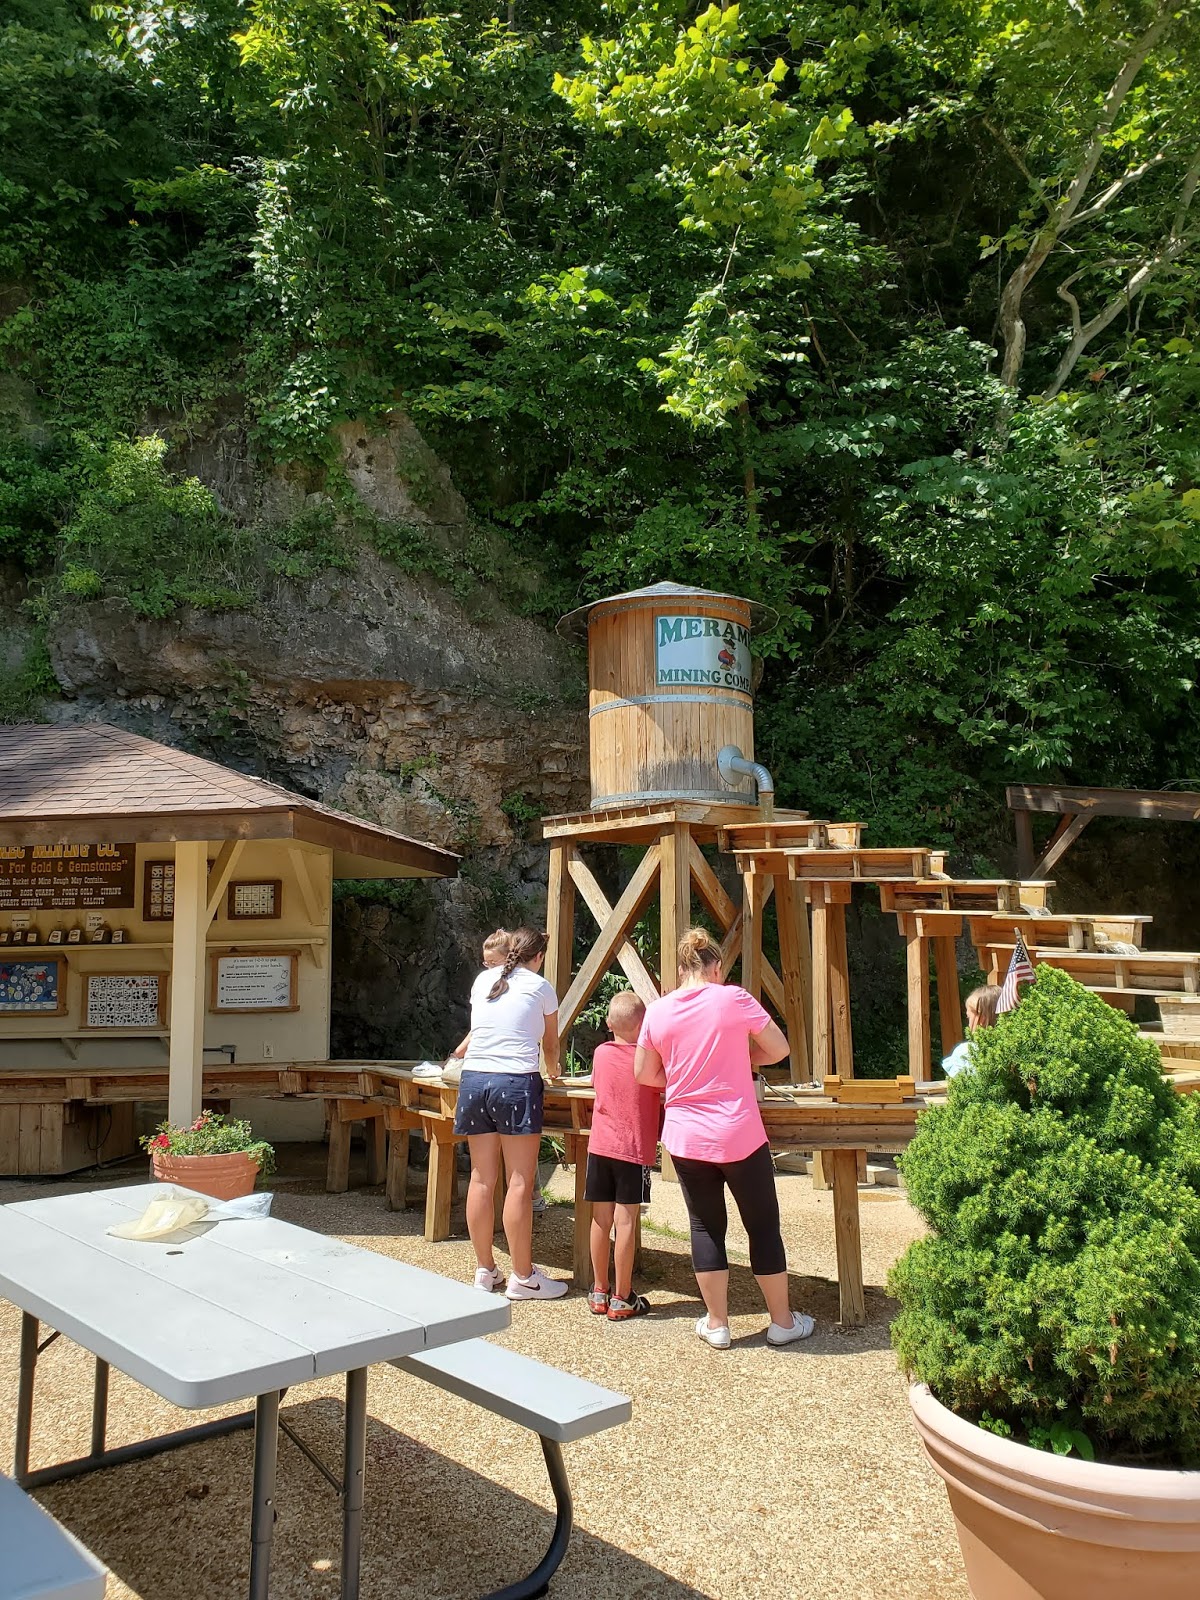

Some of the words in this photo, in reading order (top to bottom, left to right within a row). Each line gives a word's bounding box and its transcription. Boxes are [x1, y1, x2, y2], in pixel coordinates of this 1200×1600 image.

[659, 618, 750, 648] MERAM
[659, 669, 722, 684] MINING
[724, 673, 752, 692] COMP
[9, 862, 26, 873] For
[31, 861, 52, 873] Gold
[57, 861, 64, 873] &
[80, 888, 94, 896] GOLD
